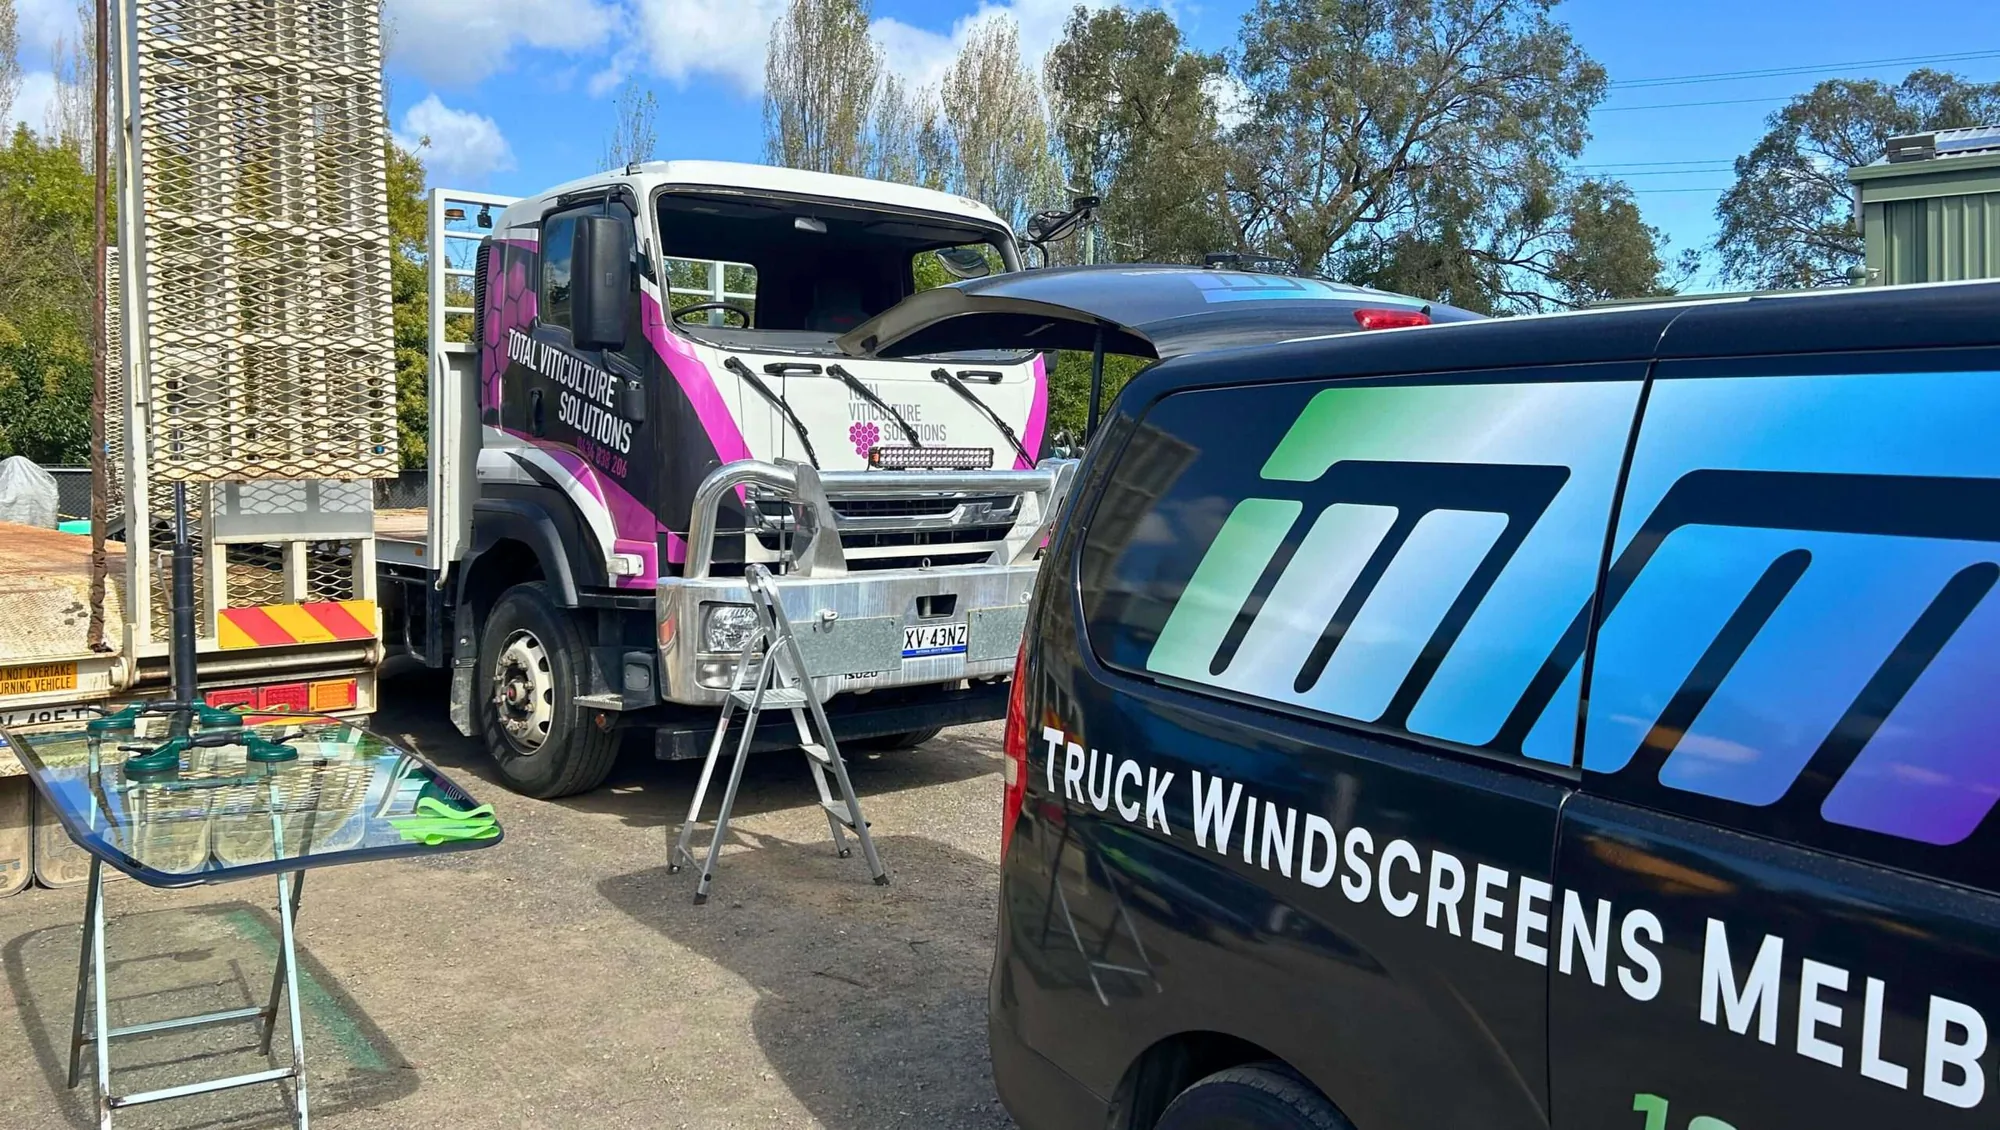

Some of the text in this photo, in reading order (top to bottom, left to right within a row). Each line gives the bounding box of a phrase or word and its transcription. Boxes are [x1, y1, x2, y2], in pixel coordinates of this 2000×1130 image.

[507, 328, 618, 408] TOTAL VITICULTURE
[558, 391, 632, 454] SOLUTIONS
[7, 668, 23, 680] NOT
[27, 663, 71, 679] OVERTAKE
[36, 676, 71, 692] VEHICLE
[1043, 726, 1989, 1109] TRUCK WINDSCREENS MELB
